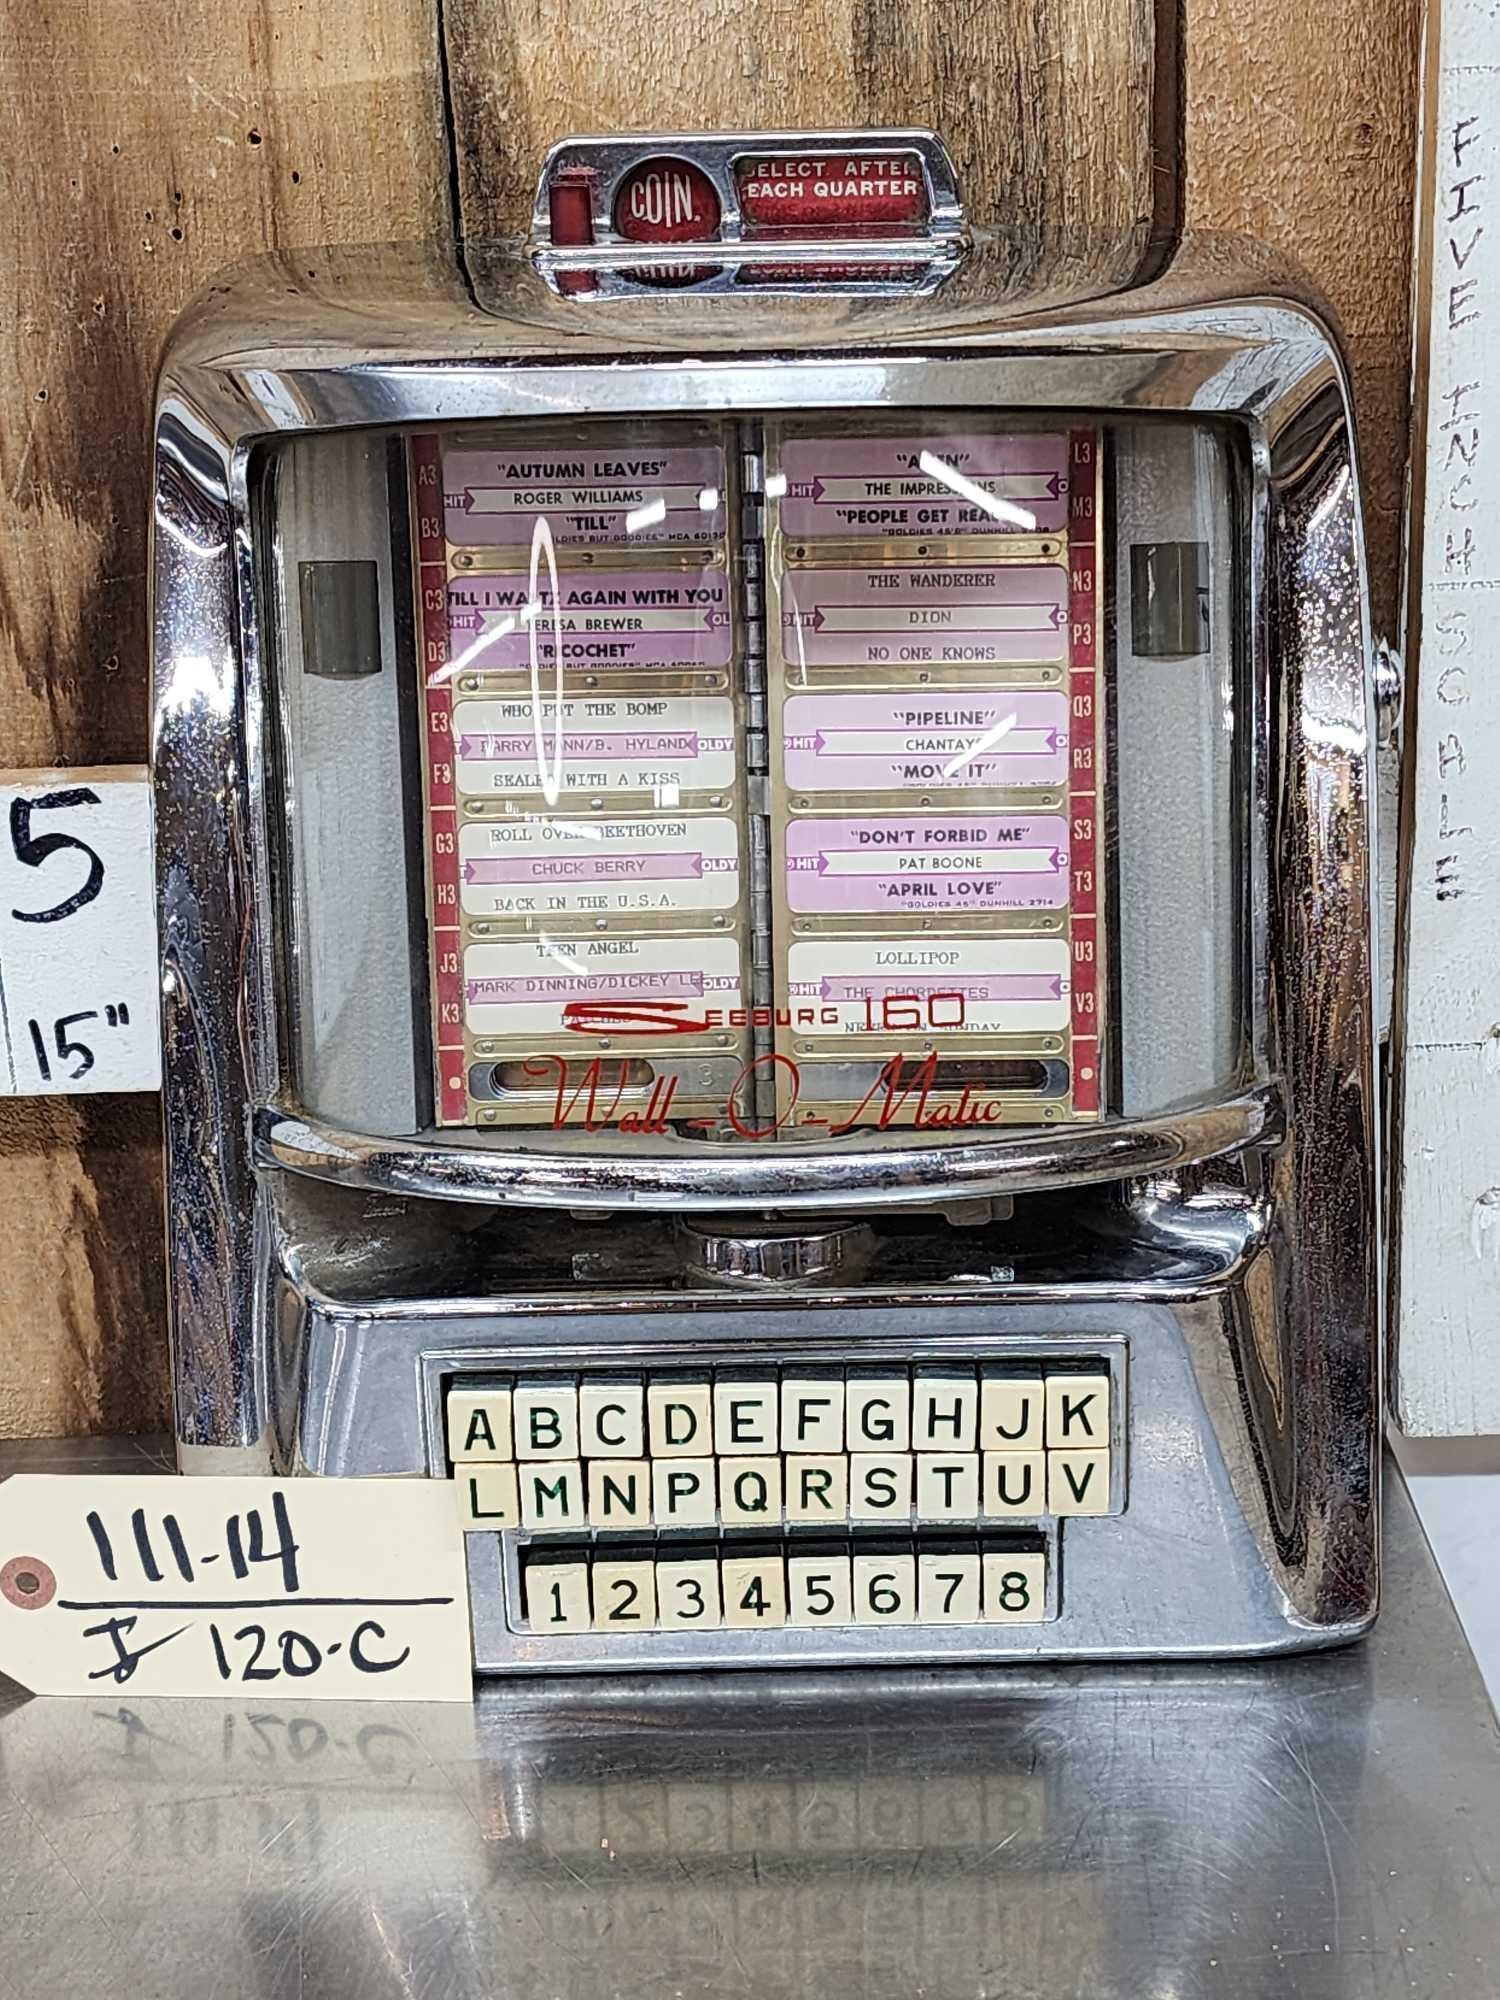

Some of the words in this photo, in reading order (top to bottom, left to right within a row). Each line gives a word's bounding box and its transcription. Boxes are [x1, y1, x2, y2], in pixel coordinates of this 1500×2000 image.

[747, 182, 804, 198] EACH
[813, 180, 917, 197] QUARTER
[631, 171, 693, 228] COIN
[1074, 442, 1090, 464] L3
[419, 464, 437, 486] A3
[497, 463, 585, 479] "AUTUMN
[594, 461, 668, 477] LEAVES"
[514, 492, 563, 505] ROGER
[572, 490, 644, 504] WILLIAMS
[792, 484, 814, 497] HIT
[865, 483, 891, 495] THE
[1072, 496, 1092, 517] M3
[565, 515, 617, 531] "TILL"
[836, 509, 908, 523] "PEOPLE
[917, 509, 949, 523] GET
[421, 517, 440, 538] B3
[868, 574, 900, 588] THE
[910, 573, 996, 587] WANDERER
[1072, 570, 1092, 591] N3
[425, 589, 443, 610] C3
[485, 592, 490, 606] I
[567, 590, 626, 605] AGAIN
[632, 589, 679, 604] WITH
[685, 588, 723, 604] YOU
[453, 617, 476, 628] HIT
[585, 618, 643, 631] BREWER
[909, 611, 952, 623] DION
[1073, 624, 1091, 645] P3
[428, 641, 446, 662] D3
[868, 647, 889, 660] NO
[900, 647, 932, 660] ONE
[942, 647, 996, 660] KNOWS
[502, 704, 532, 718] WHO
[585, 703, 616, 716] THE
[627, 702, 668, 716] BOMP
[1073, 695, 1092, 718] Q3
[431, 712, 448, 733] E3
[892, 711, 996, 726] "PIPELINE"
[625, 738, 690, 751] HYLAND
[697, 739, 734, 751] OLDY
[793, 737, 816, 750] HIT
[1073, 748, 1092, 769] R3
[433, 763, 451, 784] F3
[566, 773, 607, 787] WITH
[618, 773, 628, 786] A
[639, 772, 680, 785] KISS
[969, 763, 996, 778] IT"
[491, 829, 532, 842] ROLL
[850, 830, 915, 844] "DON'T
[924, 829, 987, 843] FORBID
[997, 828, 1030, 841] ME"
[1074, 819, 1092, 840] S3
[435, 833, 454, 853] G3
[10, 788, 105, 923] 5
[899, 857, 928, 869] PAT
[933, 857, 983, 869] BOONE
[532, 862, 584, 875] CHUCK
[595, 860, 646, 873] BERRY
[702, 859, 736, 871] OLDY
[796, 859, 819, 871] HIT
[878, 883, 938, 897] "APRIL
[948, 881, 1001, 896] LOVE"
[1074, 871, 1092, 892] T3
[437, 884, 455, 905] H3
[494, 898, 536, 911] BACK
[547, 897, 566, 909] IN
[577, 896, 608, 908] THE
[618, 894, 677, 907] U.S.A.
[588, 942, 639, 955] ANGEL
[1075, 941, 1093, 962] U3
[440, 953, 458, 973] J3
[876, 951, 959, 965] LOLLIPOP
[474, 981, 517, 994] MARK
[526, 976, 669, 992] DINNING/DICKEY
[703, 978, 738, 989] OLDY
[800, 984, 822, 995] HIT
[1076, 992, 1094, 1013] V3
[441, 1003, 459, 1024] K3
[865, 992, 965, 1032] 160
[28, 1002, 130, 1081] 15"
[465, 1410, 496, 1451] A
[531, 1408, 561, 1449] B
[596, 1404, 626, 1446] C
[666, 1403, 697, 1446] D
[731, 1400, 763, 1443] E
[798, 1398, 829, 1440] F
[861, 1399, 893, 1441] G
[928, 1397, 962, 1439] H
[996, 1397, 1029, 1440] J
[1063, 1394, 1096, 1435] K
[470, 1478, 505, 1518] L
[535, 1476, 569, 1516] M
[604, 1475, 636, 1514] N
[669, 1473, 700, 1512] P
[734, 1471, 768, 1513] Q
[802, 1469, 834, 1510] R
[865, 1468, 897, 1509] S
[931, 1467, 965, 1508] T
[998, 1465, 1032, 1505] U
[1063, 1463, 1095, 1503] V
[86, 1491, 300, 1593] 111-14
[549, 1583, 568, 1622] 1
[609, 1580, 640, 1620] 2
[676, 1579, 704, 1618] 3
[739, 1578, 770, 1617] 4
[807, 1576, 835, 1615] 5
[869, 1575, 901, 1614] 6
[935, 1574, 964, 1613] 7
[999, 1571, 1030, 1611] 8
[210, 1620, 411, 1682] 120-C
